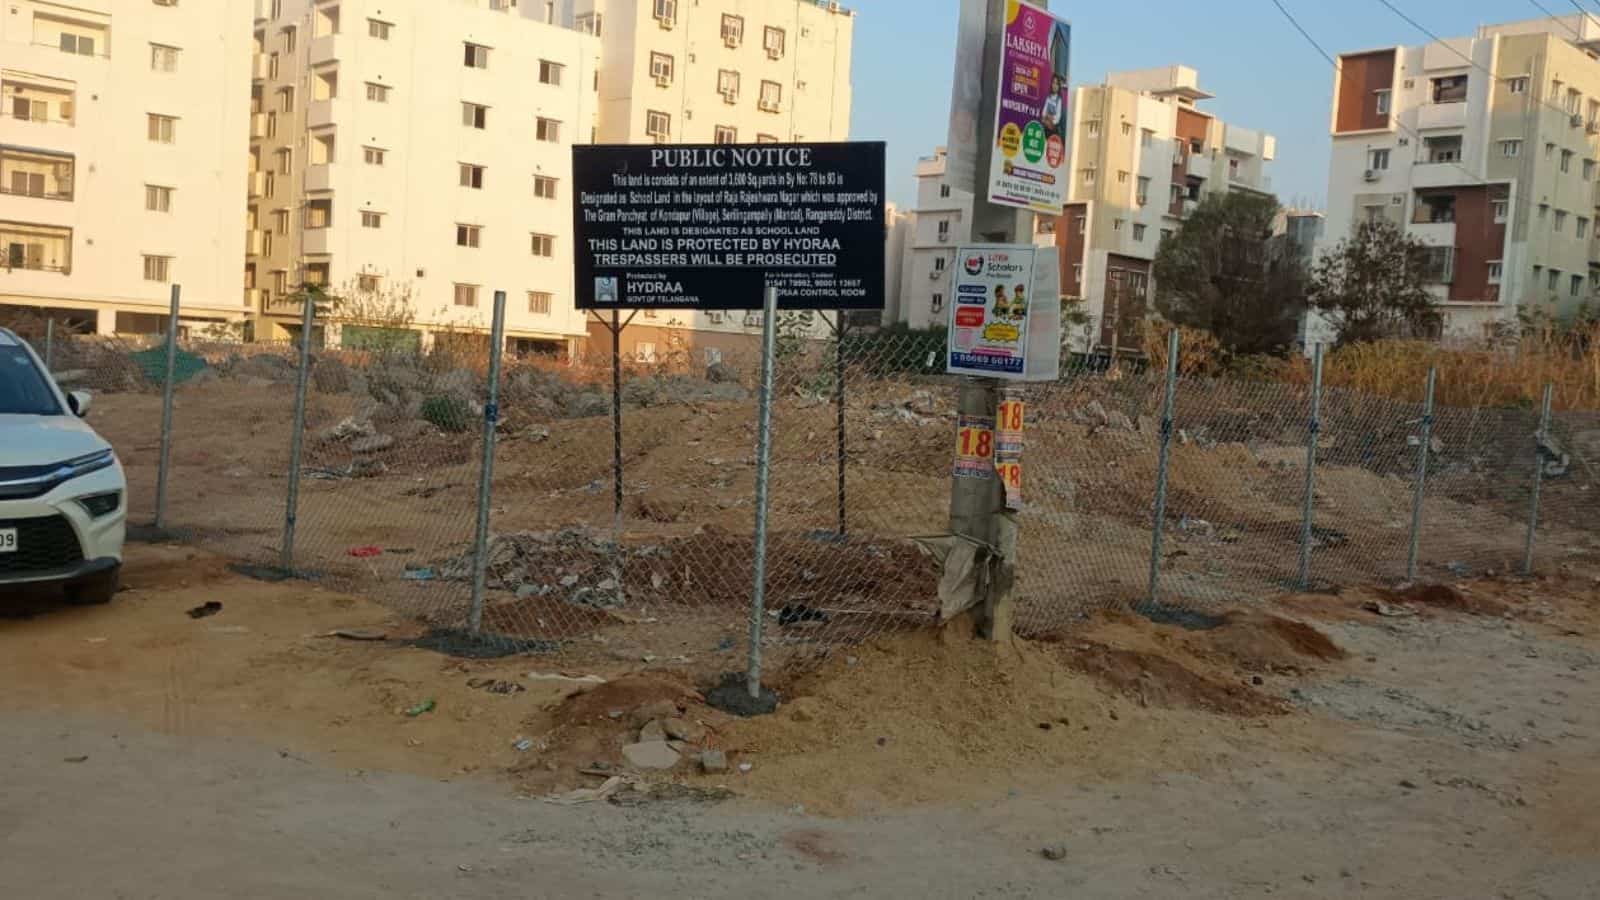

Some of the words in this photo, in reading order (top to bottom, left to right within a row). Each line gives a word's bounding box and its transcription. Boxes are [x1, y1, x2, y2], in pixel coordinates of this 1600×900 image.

[1007, 33, 1048, 60] LAKSHYA
[1002, 98, 1029, 113] NURSERY
[651, 148, 726, 168] PUBLIC
[731, 147, 812, 167] NOTICE
[612, 174, 626, 186] This
[628, 174, 643, 186] land
[644, 174, 650, 186] is
[651, 173, 679, 186] consists
[680, 173, 688, 186] of
[688, 176, 697, 186] an
[698, 174, 719, 186] extent
[720, 173, 728, 185] of
[778, 172, 784, 185] in
[786, 172, 795, 188] Sy
[818, 172, 826, 185] to
[837, 171, 844, 185] is
[580, 191, 617, 207] Designated
[619, 194, 626, 204] as
[630, 191, 652, 204] School
[654, 191, 671, 204] Land
[673, 191, 681, 203] in
[682, 191, 693, 203] the
[694, 191, 714, 207] layout
[714, 191, 723, 203] of
[779, 190, 799, 206] Nagar
[801, 190, 820, 203] which
[822, 193, 835, 203] was
[837, 189, 867, 206] approved
[868, 189, 878, 206] by
[584, 208, 597, 222] The
[598, 208, 616, 222] Gram
[649, 208, 658, 221] of
[658, 208, 691, 224] Kondapur
[805, 207, 846, 224] Rangareddy
[623, 227, 642, 235] THIS
[645, 227, 669, 235] LAND
[671, 227, 680, 235] IS
[682, 226, 739, 235] DESIGNATED
[740, 226, 753, 235] AS
[755, 226, 793, 235] SCHOOL
[795, 226, 820, 235] LAND
[588, 239, 617, 250] THIS
[621, 239, 657, 250] LAND
[661, 239, 673, 250] IS
[677, 238, 758, 250] PROTECTED
[762, 238, 780, 250] BY
[783, 238, 841, 250] HYDRAA
[594, 253, 687, 265] TRESPASSERS
[690, 253, 723, 265] WILL
[726, 253, 743, 265] BE
[747, 253, 837, 265] PROSECUTED
[988, 263, 1023, 273] Scholars
[626, 282, 683, 293] HYDRAA
[800, 288, 839, 297] CONTROL
[841, 287, 866, 297] ROOM
[960, 428, 991, 457] 1.8
